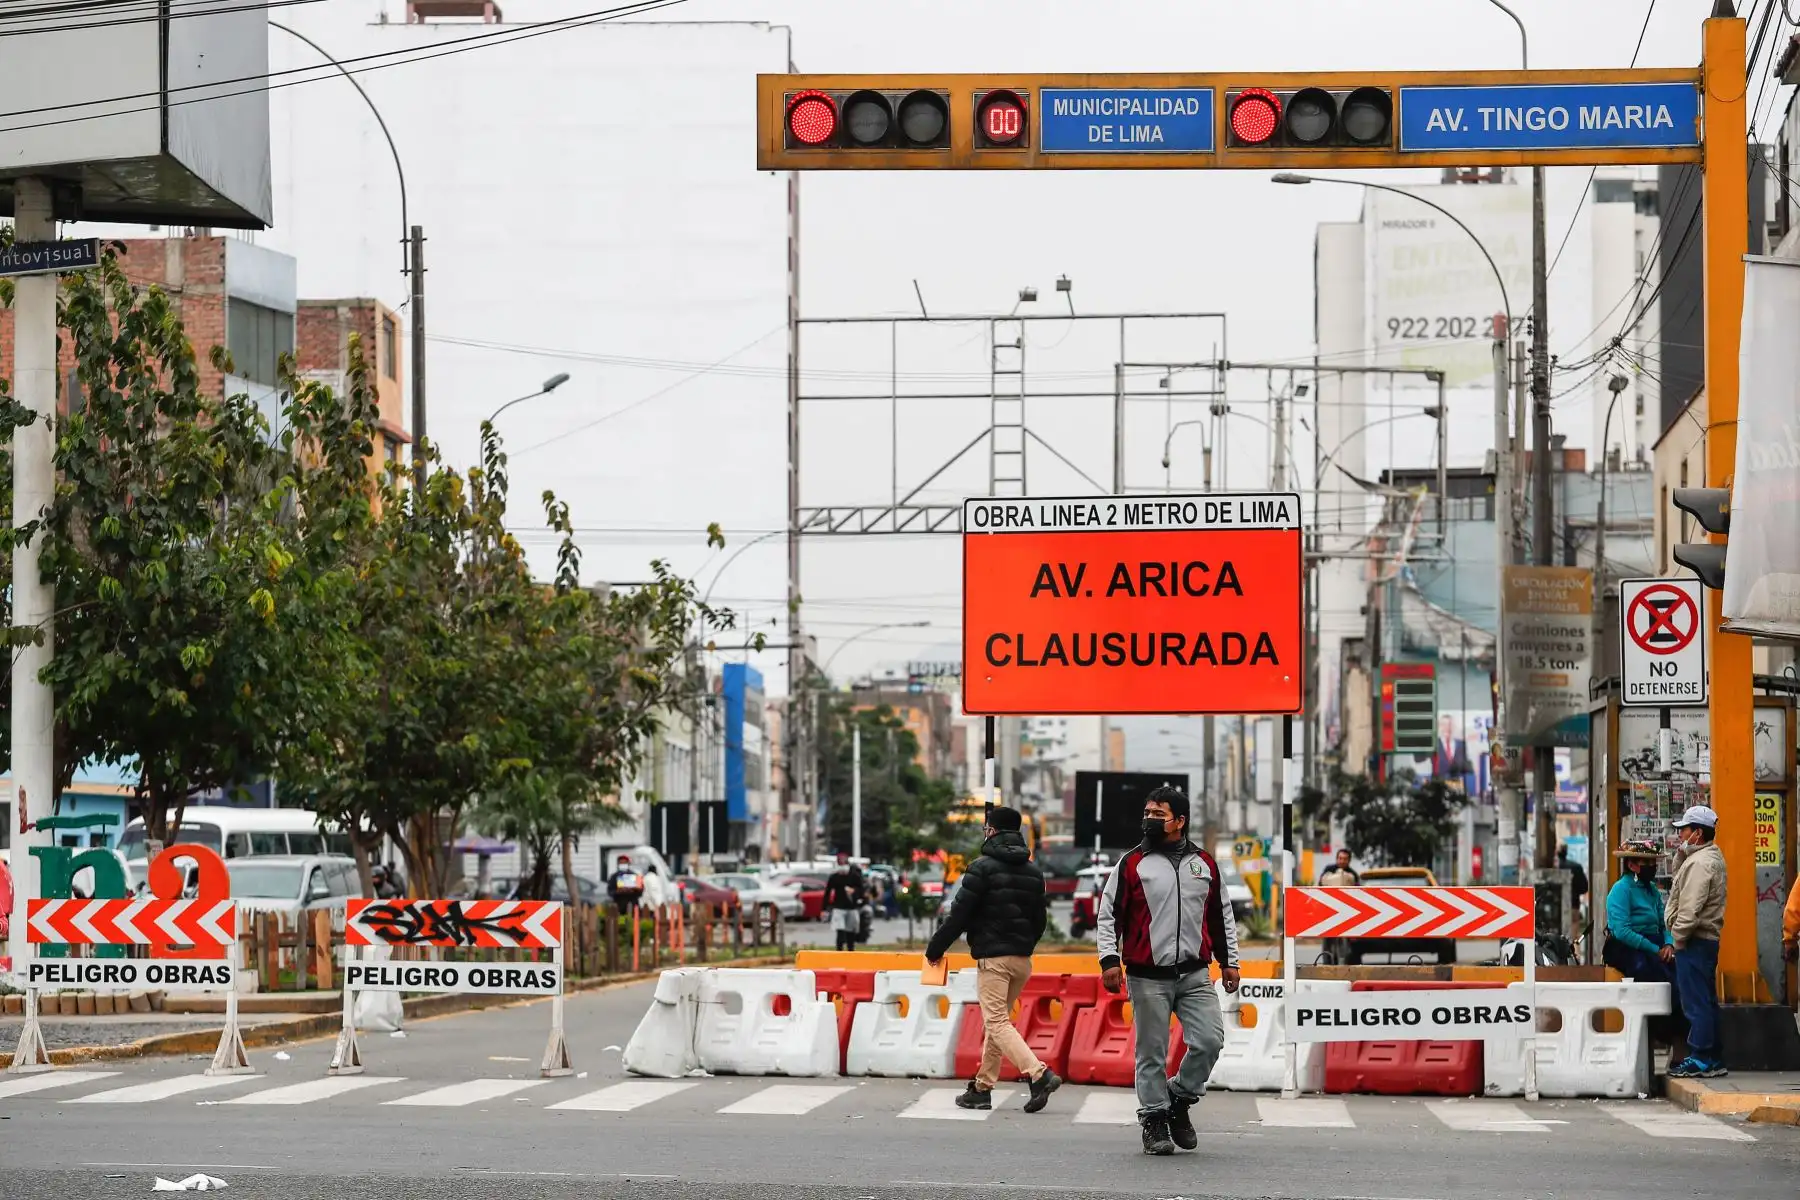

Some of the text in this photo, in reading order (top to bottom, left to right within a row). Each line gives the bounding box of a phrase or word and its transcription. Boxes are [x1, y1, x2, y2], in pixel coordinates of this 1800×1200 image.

[1053, 97, 1199, 117] MUNICIPALIDAD
[989, 108, 1019, 135] 00
[1426, 105, 1674, 133] AV. TINGO MARIA
[1088, 125, 1164, 143] DE LIMA
[1387, 316, 1525, 339] 922 202 27
[974, 501, 1290, 528] OBRA LINEA 2 METRO DE LIMA
[1030, 561, 1244, 598] AV. ARICA
[1511, 622, 1586, 637] Camiones
[985, 631, 1280, 667] CLAUSURADA
[1509, 641, 1585, 657] mayores a
[1517, 656, 1580, 671] 18.5 ton.
[1649, 661, 1678, 678] NO
[1630, 682, 1699, 696] DETENERSE
[29, 964, 231, 985] PELIGRO OBRAS
[347, 966, 557, 988] PELIGRO OBRAS
[1240, 985, 1284, 998] CCM2
[1297, 1004, 1532, 1027] PELIGRO OBRAS
